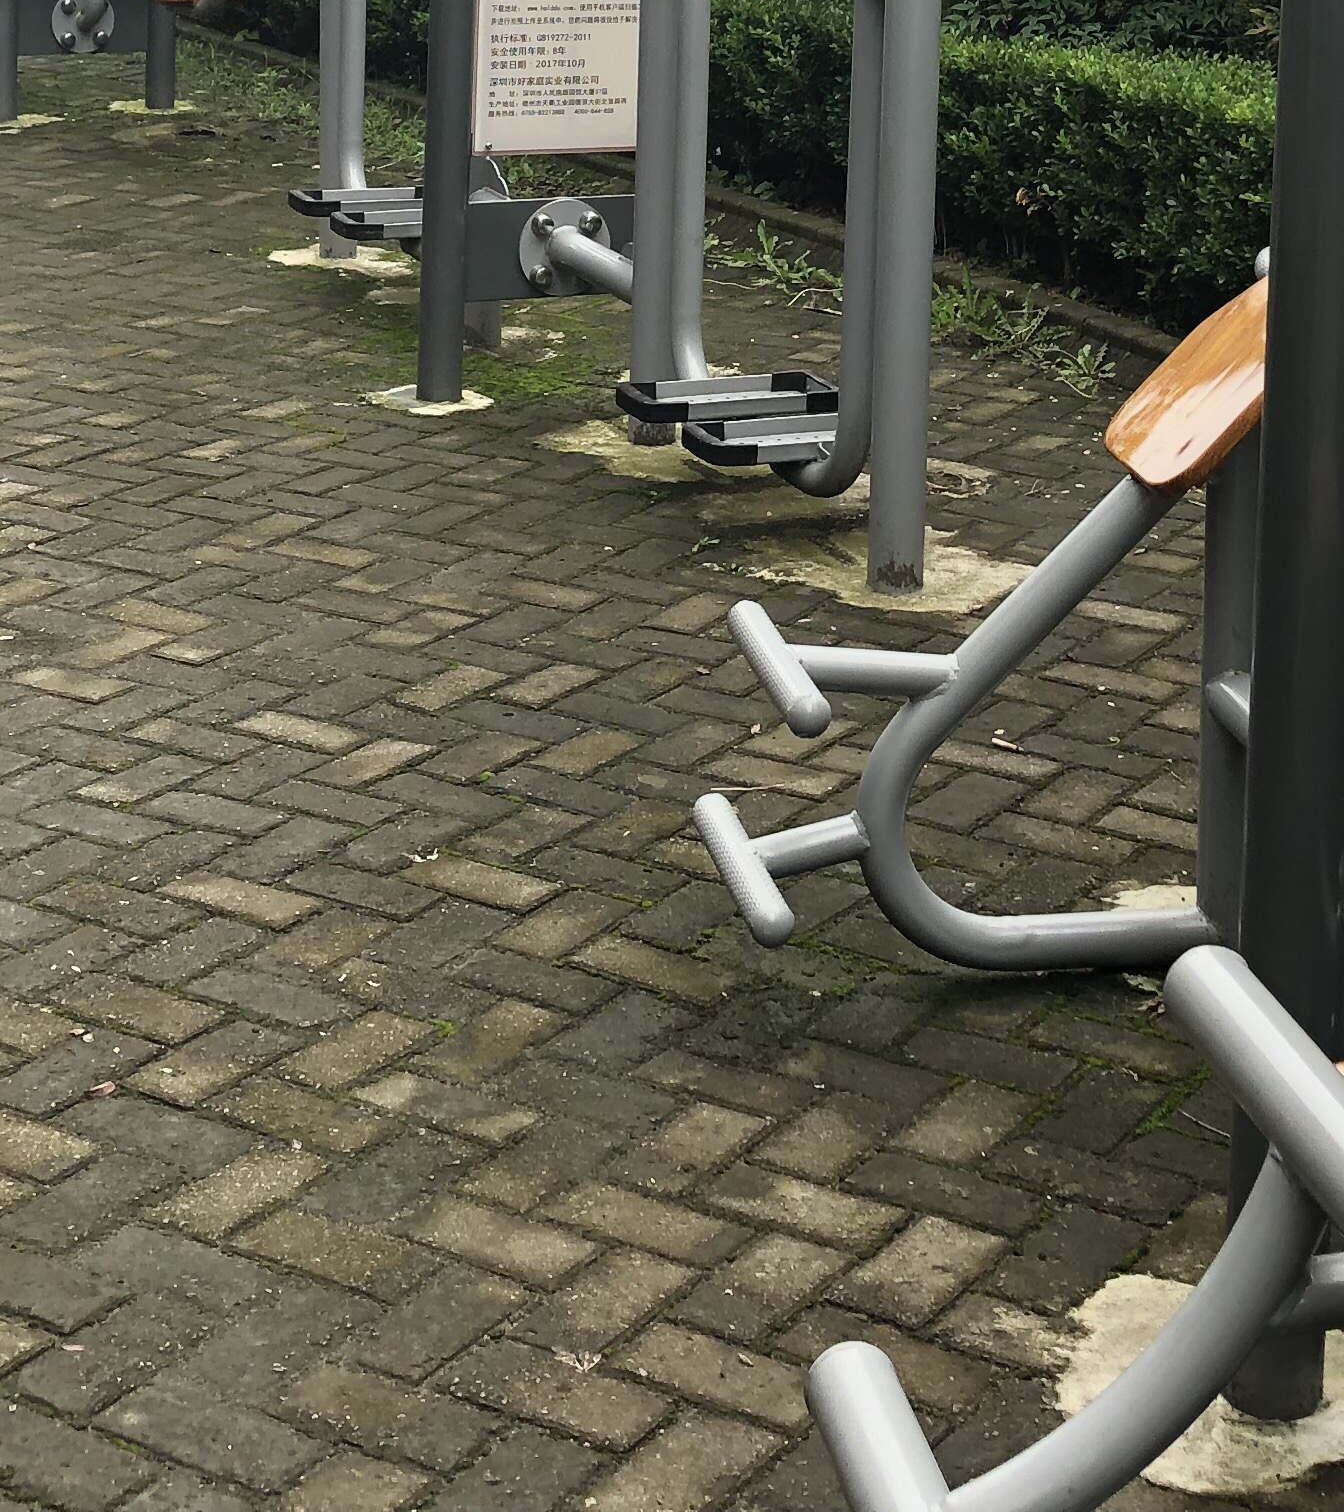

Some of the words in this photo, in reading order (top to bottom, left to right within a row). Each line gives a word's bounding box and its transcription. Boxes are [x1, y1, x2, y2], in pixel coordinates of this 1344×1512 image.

[489, 75, 599, 87] 深圳市好家庭实业有限公司
